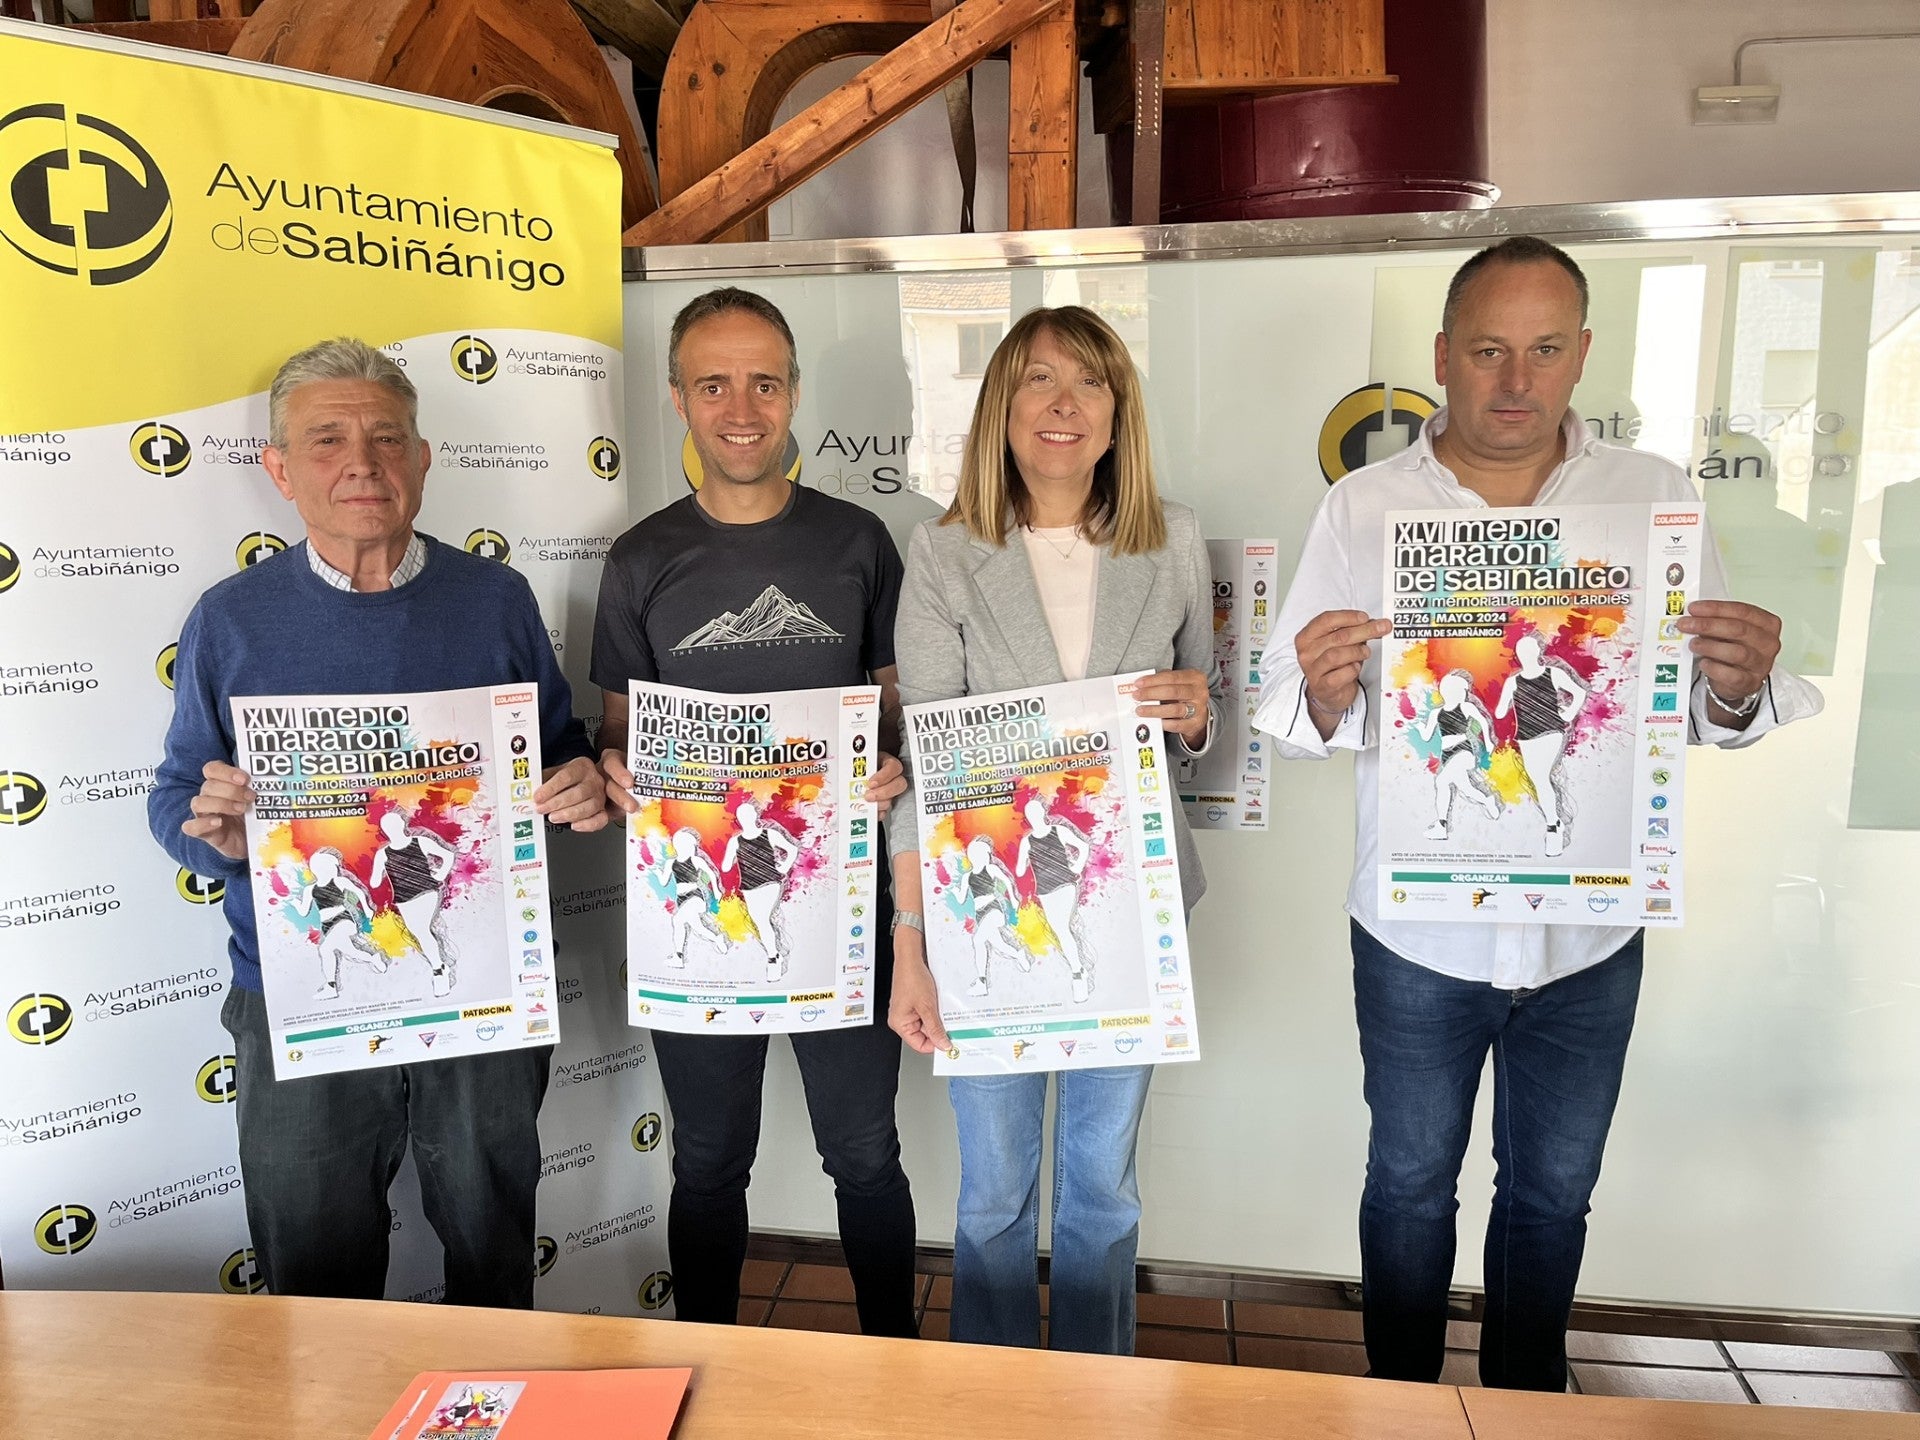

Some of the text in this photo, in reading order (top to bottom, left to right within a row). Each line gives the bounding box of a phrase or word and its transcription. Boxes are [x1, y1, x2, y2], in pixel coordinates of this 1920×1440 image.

[206, 162, 554, 242] Ayuntamiento
[506, 348, 604, 365] Ayuntamiento
[202, 435, 268, 450] Ayunta
[440, 441, 545, 455] Ayuntamiento
[1396, 522, 1444, 543] XLVI
[519, 536, 613, 548] Ayuntamiento
[33, 545, 174, 562] Ayuntamiento
[520, 550, 609, 562] deSabiñánig
[1394, 597, 1427, 608] XXXV
[1395, 612, 1507, 626] 25/26 MAYO 2024
[1405, 629, 1415, 638] 10
[1417, 630, 1432, 638] KM
[1433, 630, 1445, 638] DE
[704, 644, 744, 652] TRAIL
[755, 639, 801, 648] NEVER
[0, 661, 93, 680] tamiento
[0, 677, 99, 697] biñánigo
[638, 692, 677, 716] XLVI
[246, 708, 295, 728] XLVI
[915, 710, 954, 733] XLVI
[635, 759, 660, 771] XXXV
[59, 764, 156, 789] Ayuntami
[635, 773, 727, 791] 25/26 MAYO 2024
[923, 776, 949, 788] XXXV
[253, 781, 285, 791] XXXV
[652, 789, 664, 797] KM
[926, 783, 1015, 802] 25/26 MAYO 2024
[256, 793, 368, 807] 25/26 MAYO 2024
[268, 810, 278, 818] 10
[280, 810, 294, 818] KM
[296, 810, 308, 818] DE
[934, 805, 944, 813] 10
[945, 803, 956, 811] KM
[957, 802, 967, 810] DE
[1451, 874, 1510, 883] ORGANIZAN
[1575, 876, 1629, 885] PATROCINA
[0, 883, 115, 911] untamiento
[0, 899, 120, 928] Sabiñánigo
[84, 966, 218, 1007] Ayuntamiento
[686, 996, 737, 1004] ORGANIZAN
[790, 992, 834, 1002] PATROCINA
[463, 1005, 512, 1018] PATROCINA
[345, 1018, 404, 1034] ORGANIZAN
[1102, 1015, 1150, 1027] PATROCINA
[993, 1024, 1045, 1036] ORGANIZAN
[554, 1042, 645, 1077] Ayuntamiento
[540, 1142, 592, 1165] amiento
[108, 1164, 236, 1213] Ayuntamiento
[565, 1203, 654, 1243] Ayuntamiento
